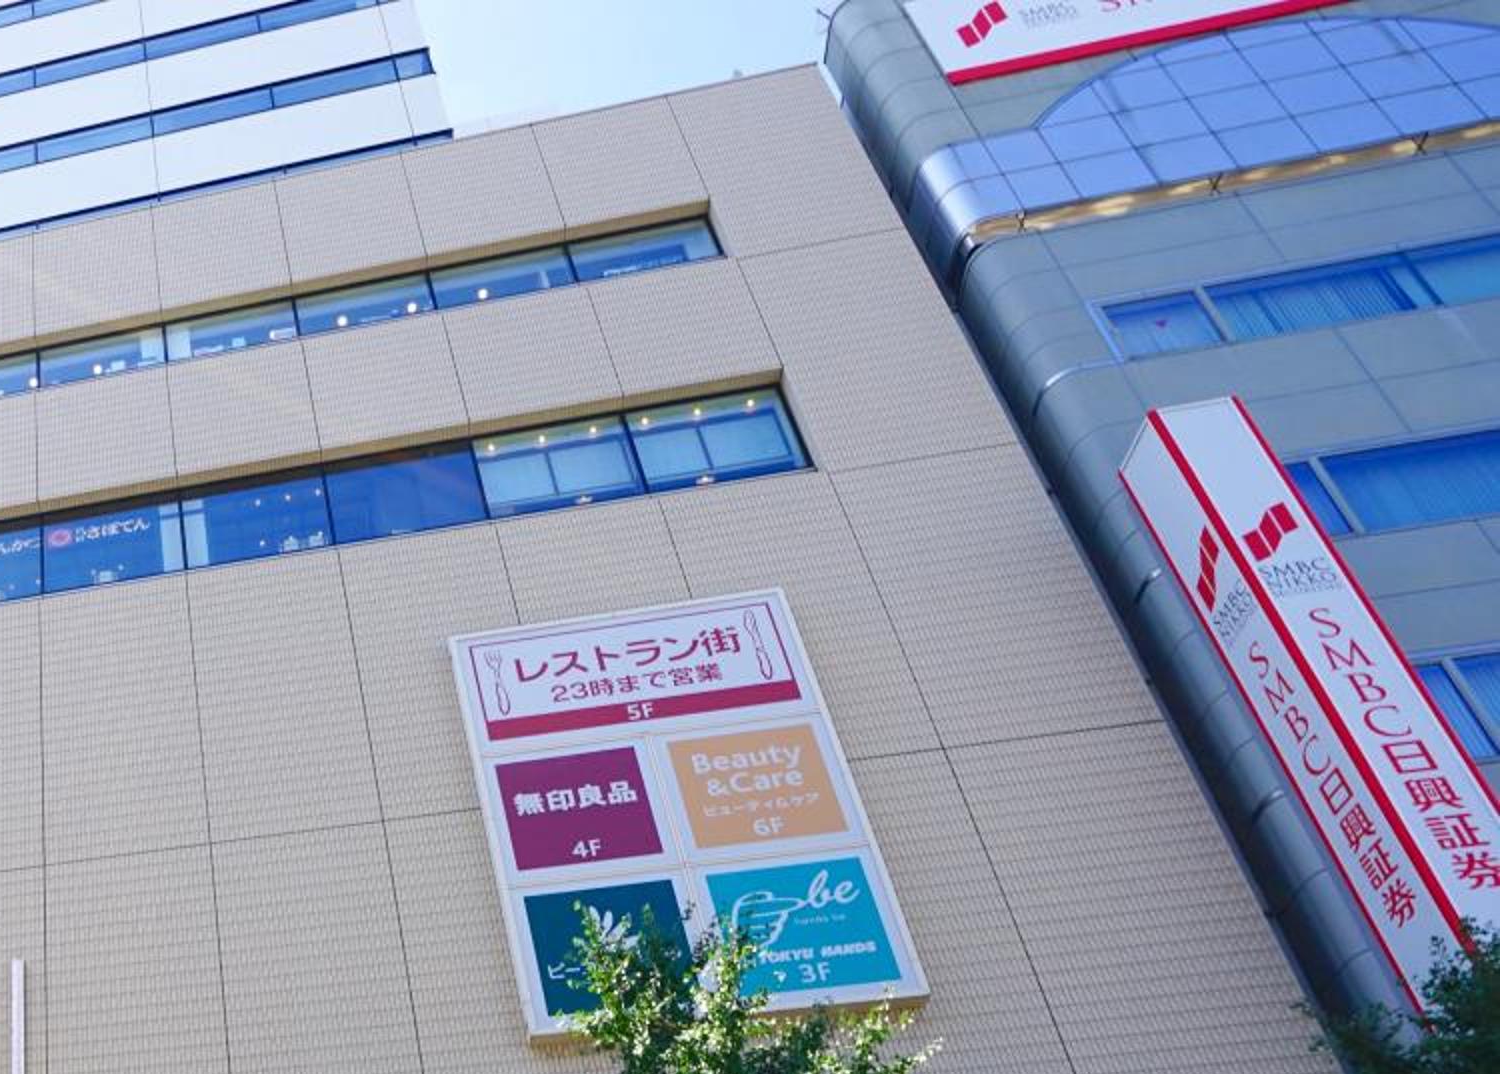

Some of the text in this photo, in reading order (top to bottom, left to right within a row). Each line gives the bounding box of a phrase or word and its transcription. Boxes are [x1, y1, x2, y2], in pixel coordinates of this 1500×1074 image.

[515, 627, 741, 682] レストラン街
[551, 663, 723, 702] 23時まで営業
[627, 702, 654, 720] 5F
[691, 745, 801, 775] Beauty
[1308, 607, 1500, 889] SMBC日興証券
[707, 769, 804, 797] &Care
[1249, 640, 1417, 928] SMBC日興証券
[514, 781, 638, 816] 無印良品
[753, 815, 785, 837] 6F
[572, 838, 601, 857] 4F
[758, 941, 877, 965] TOKYU HANDS
[798, 961, 831, 983] 3F
